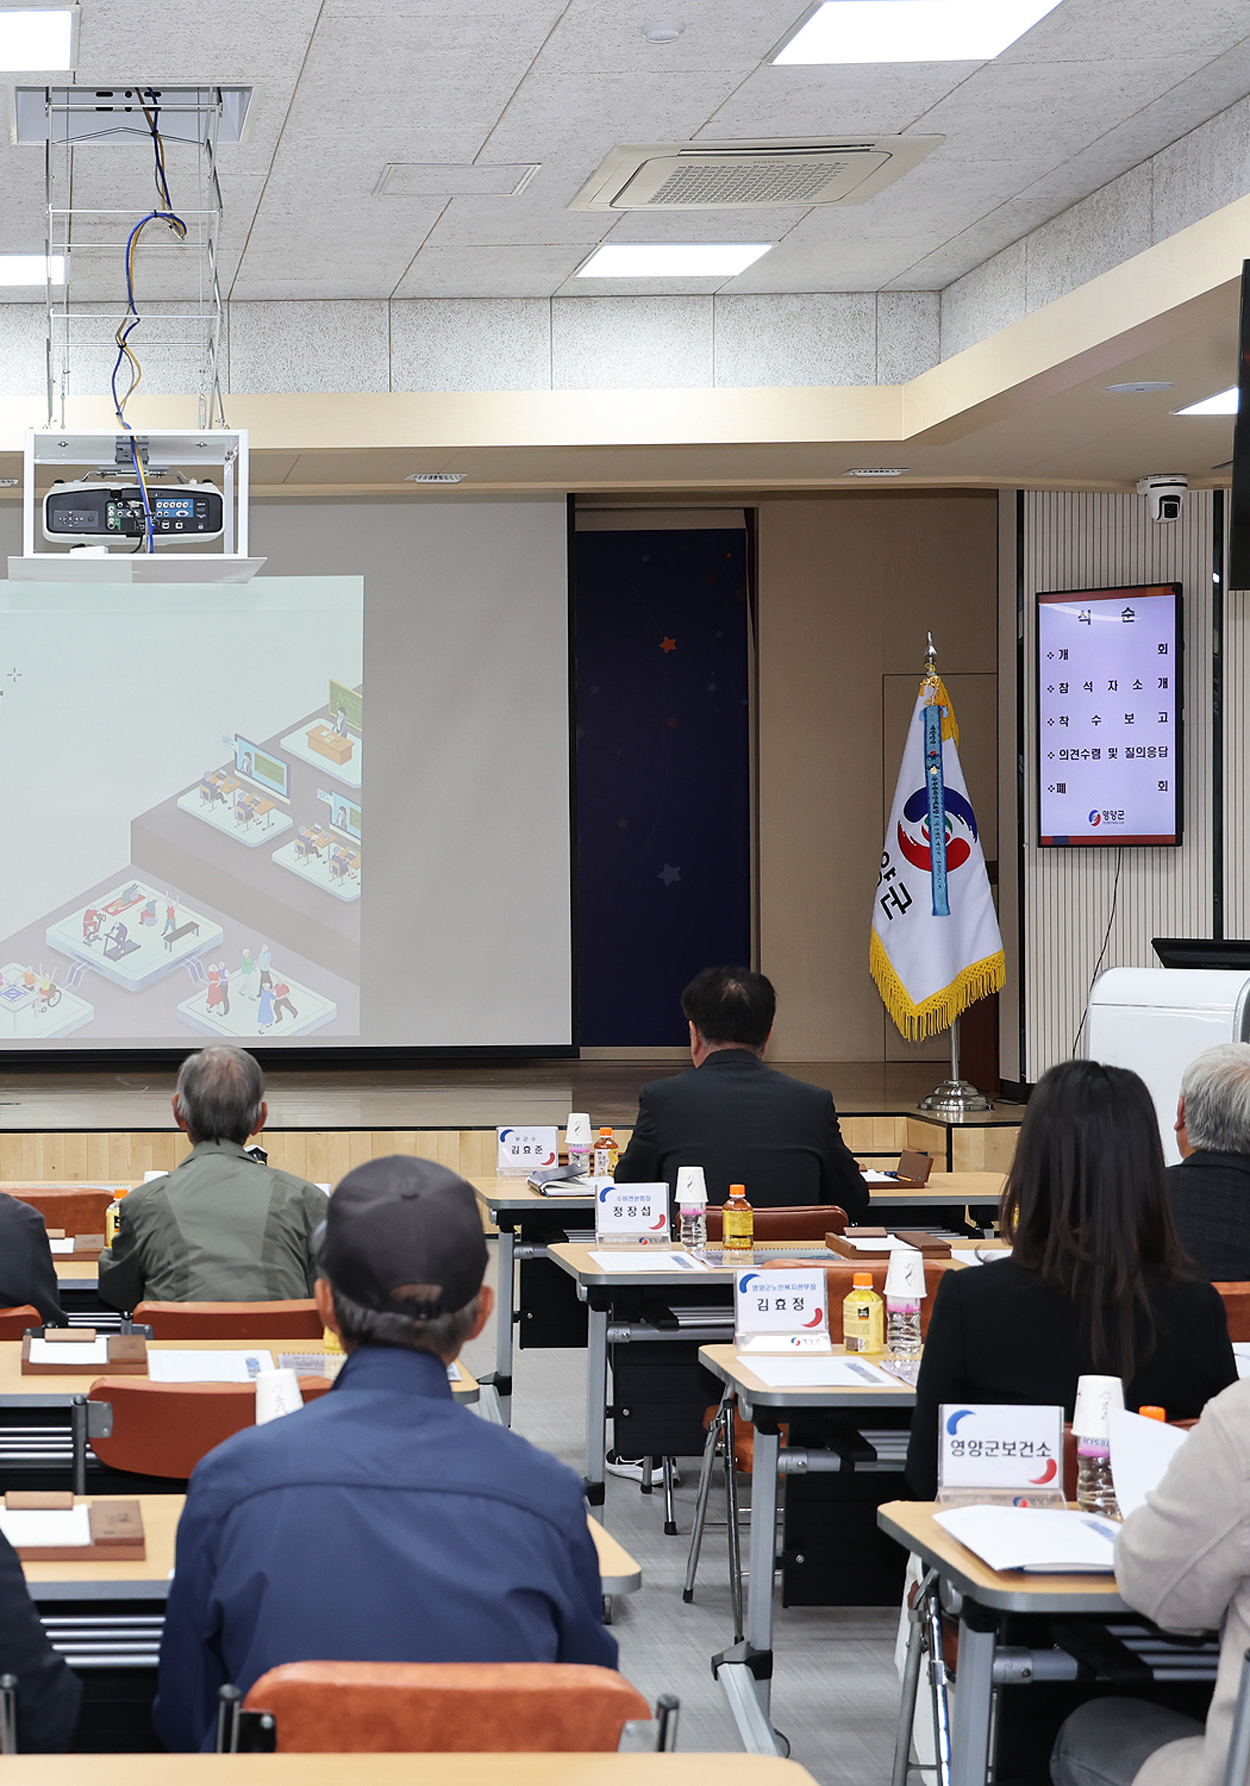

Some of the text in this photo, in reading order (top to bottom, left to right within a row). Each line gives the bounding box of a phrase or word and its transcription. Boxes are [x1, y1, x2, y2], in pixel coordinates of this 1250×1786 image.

[1059, 745, 1169, 761] 의견수렴 및 질의응답
[1102, 810, 1125, 822] 영양군
[877, 851, 913, 921] 양군
[950, 1439, 1052, 1459] 영양군보건소
